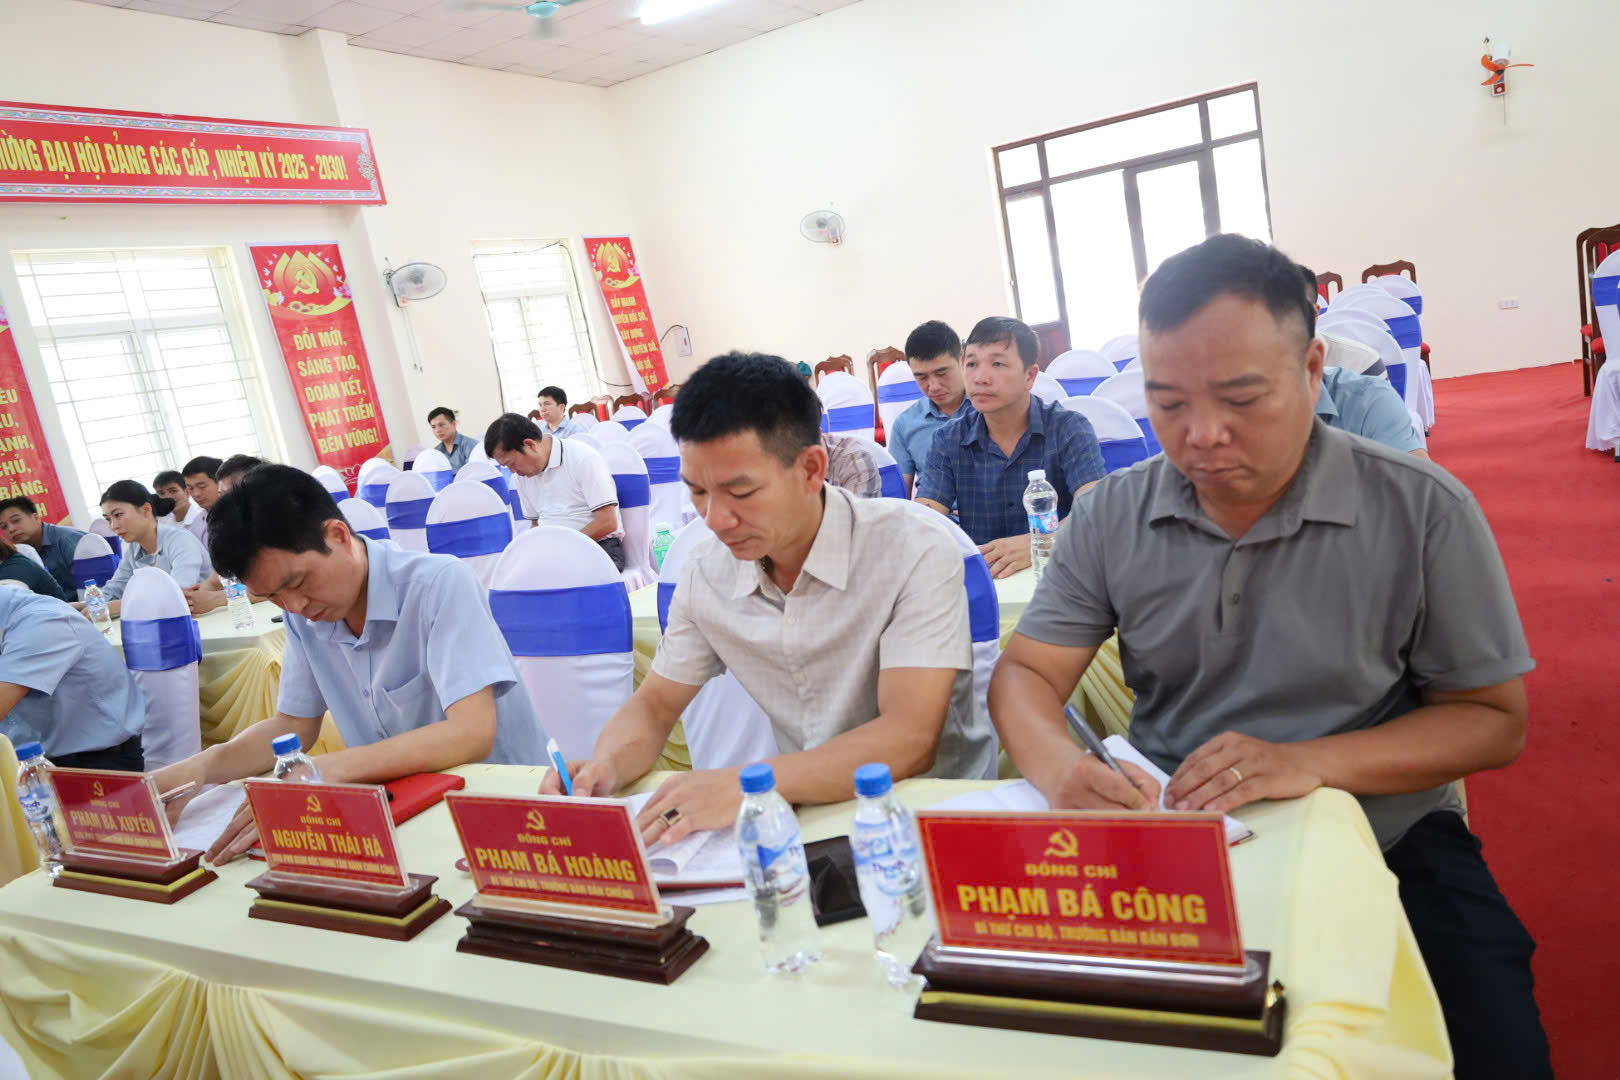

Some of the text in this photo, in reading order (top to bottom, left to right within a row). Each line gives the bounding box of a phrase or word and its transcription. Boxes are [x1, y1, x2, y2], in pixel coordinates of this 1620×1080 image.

[41, 140, 76, 180] ĐẠI
[73, 135, 106, 180] HỘI
[103, 130, 150, 175] ĐẢNG
[150, 140, 181, 176] CÁC
[214, 144, 261, 184] NHIỆM
[258, 145, 278, 178] KỲ
[277, 152, 309, 180] 2025
[315, 154, 349, 181] 2030!
[297, 356, 333, 377] SÁNG
[272, 825, 328, 853] NGUYỄN
[474, 847, 637, 882] PHẠM BÁ HOÀNG
[956, 884, 1207, 924] PHẠM BÁ CÔNG
